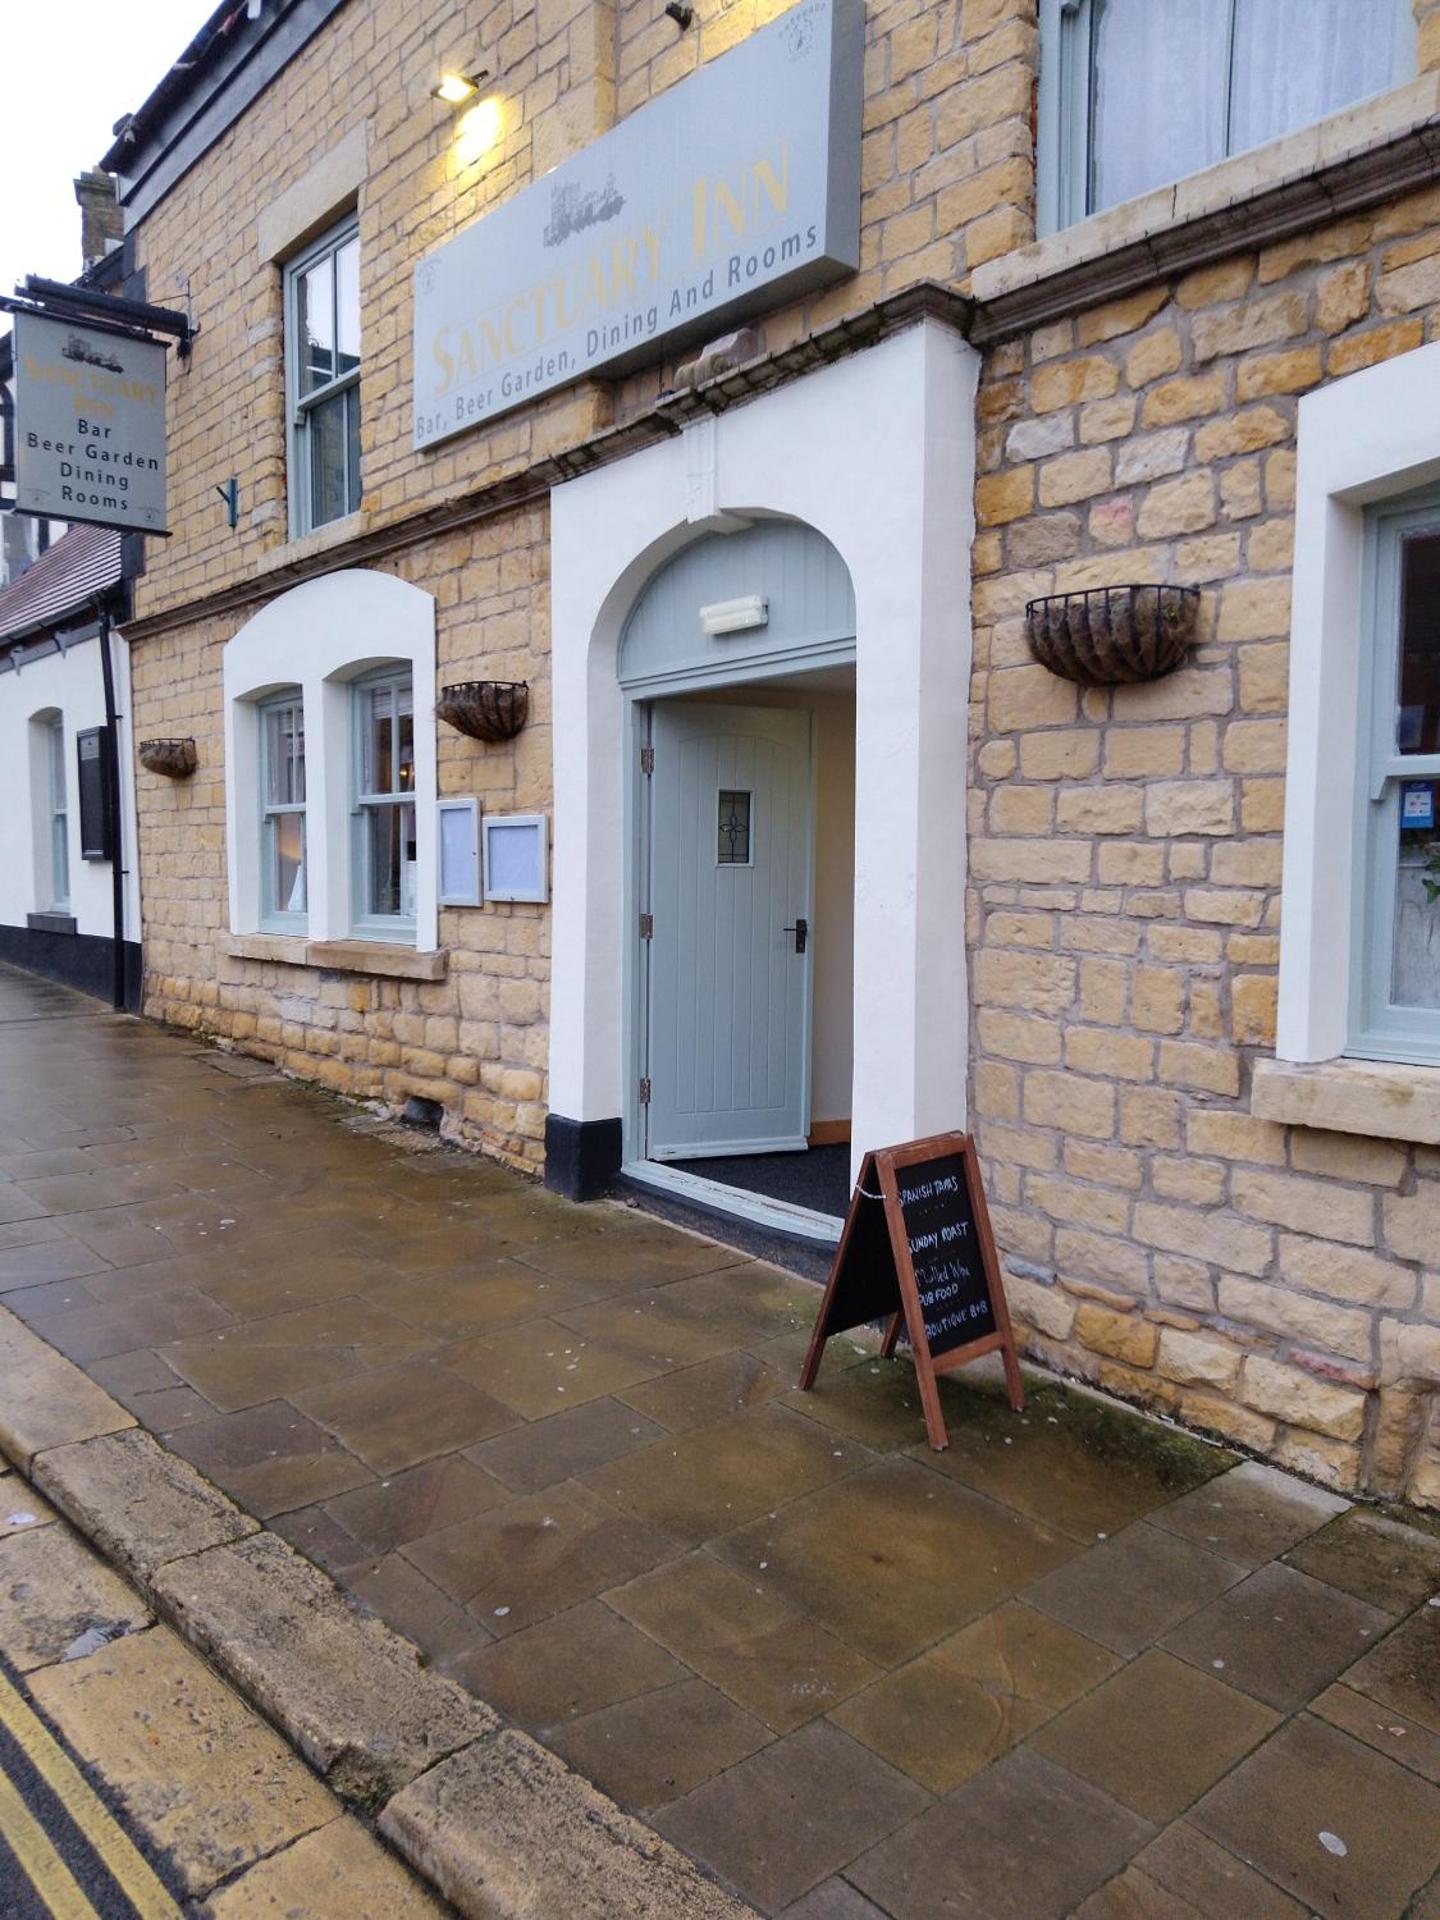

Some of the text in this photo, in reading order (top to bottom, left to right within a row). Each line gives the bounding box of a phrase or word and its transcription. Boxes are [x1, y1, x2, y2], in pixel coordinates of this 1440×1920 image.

[433, 139, 789, 396] SANCTUARY INN
[416, 225, 817, 439] Bar, Beer Garden, Dining And Rooms
[78, 419, 112, 439] Bar
[27, 432, 158, 470] Beer Garden
[61, 463, 129, 490] Dining
[62, 486, 128, 511] Rooms
